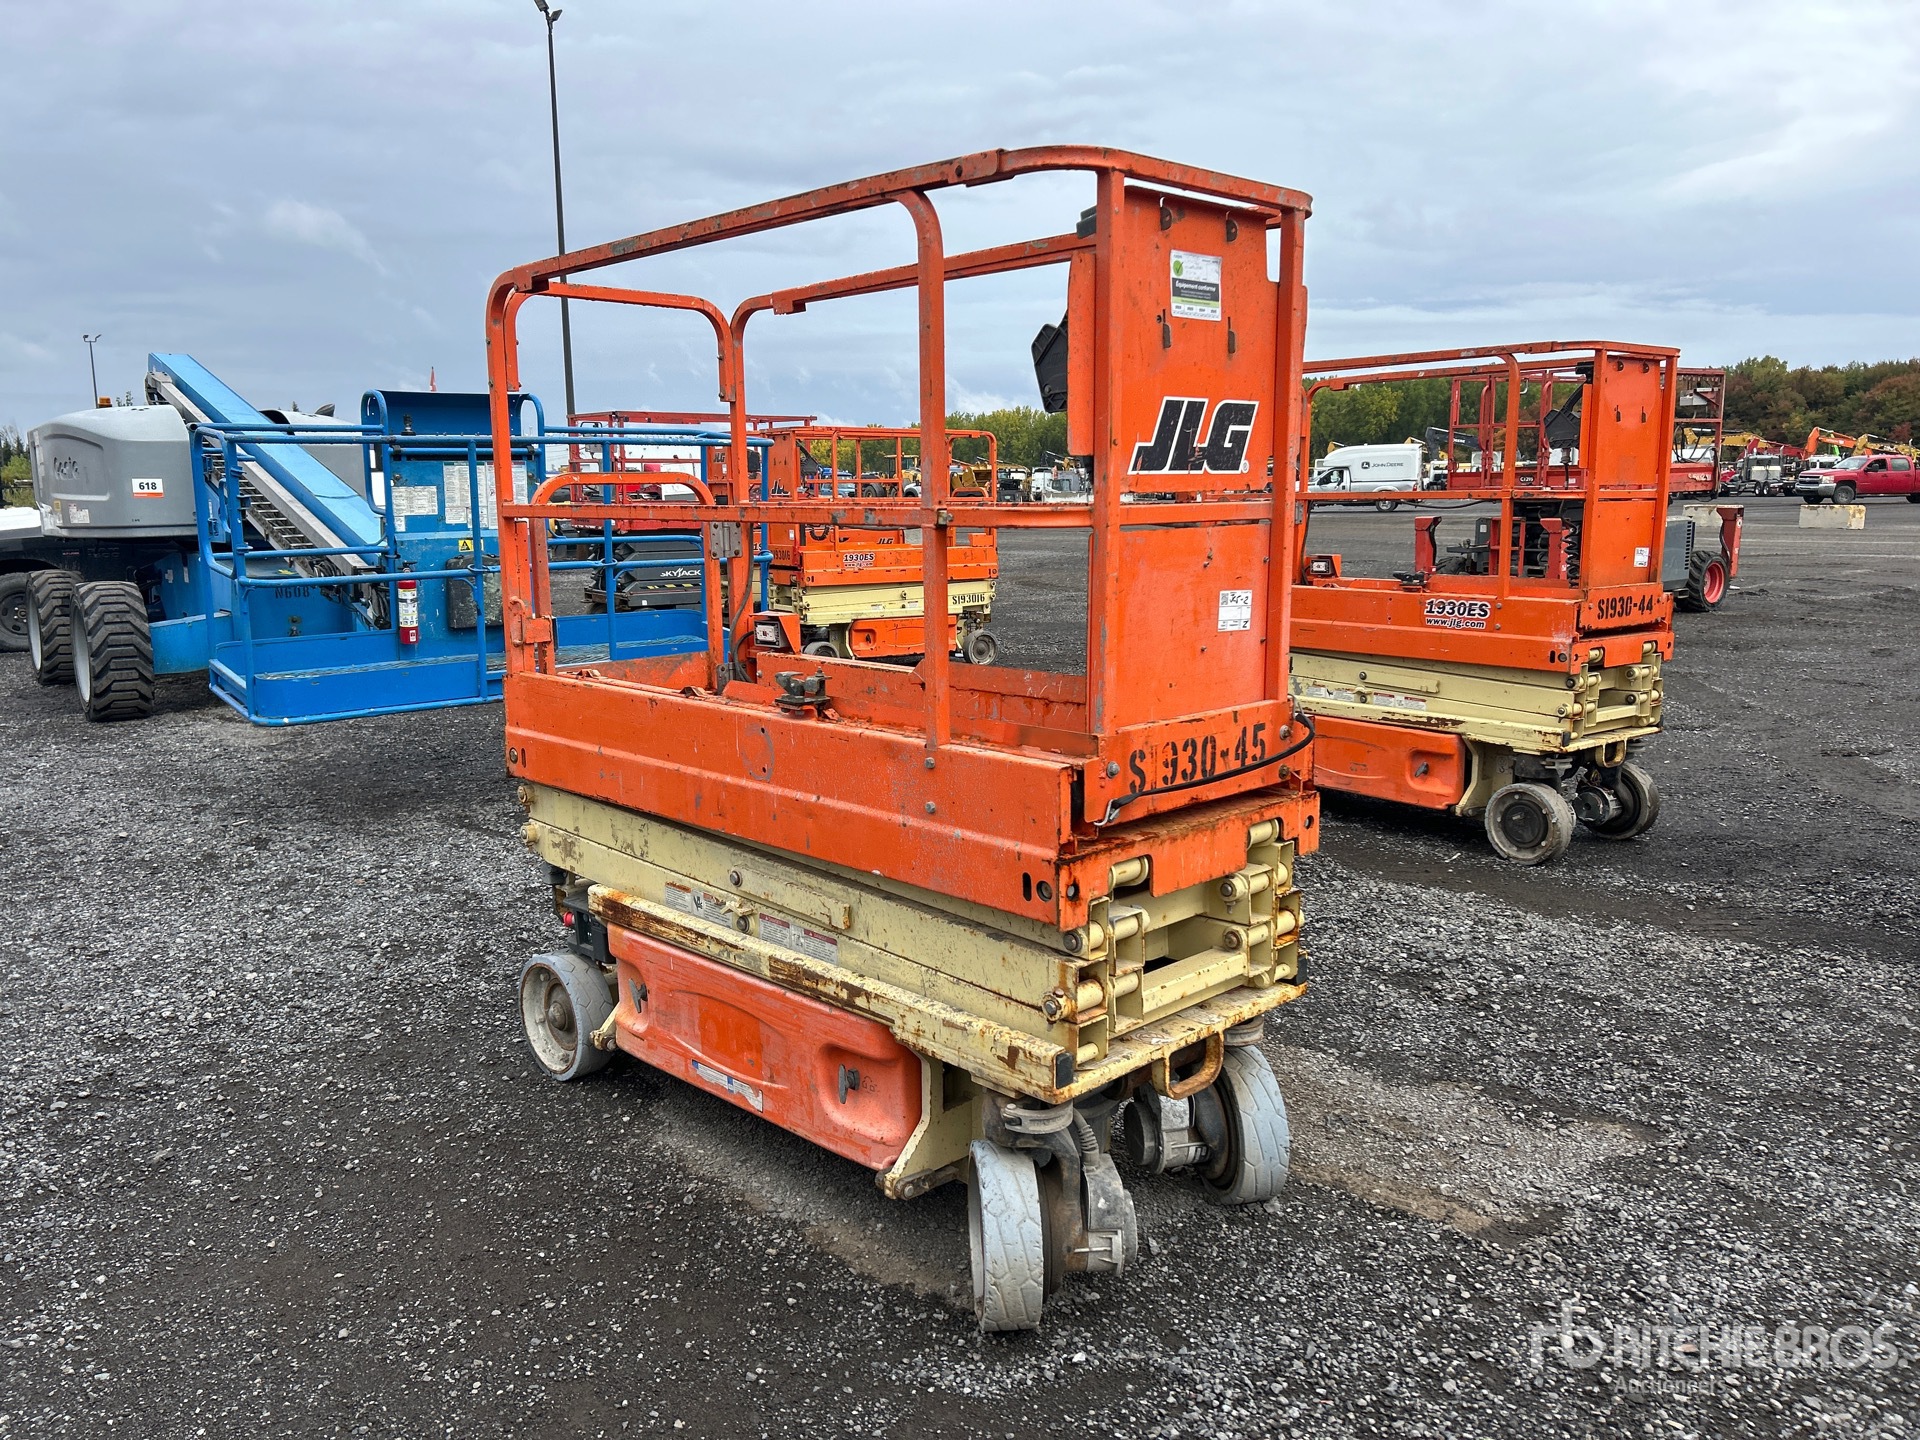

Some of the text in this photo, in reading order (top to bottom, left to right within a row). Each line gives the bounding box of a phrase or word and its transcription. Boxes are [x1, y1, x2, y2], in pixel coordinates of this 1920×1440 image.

[1129, 397, 1258, 474] JLG
[138, 481, 157, 490] 618
[876, 537, 894, 545] JLG
[843, 553, 875, 562] 1930ES
[659, 567, 702, 578] SKYJACK
[274, 585, 310, 599] N608
[952, 593, 985, 605] S193016
[1424, 598, 1490, 618] 1930ES
[1425, 616, 1485, 629] www.jlg.com
